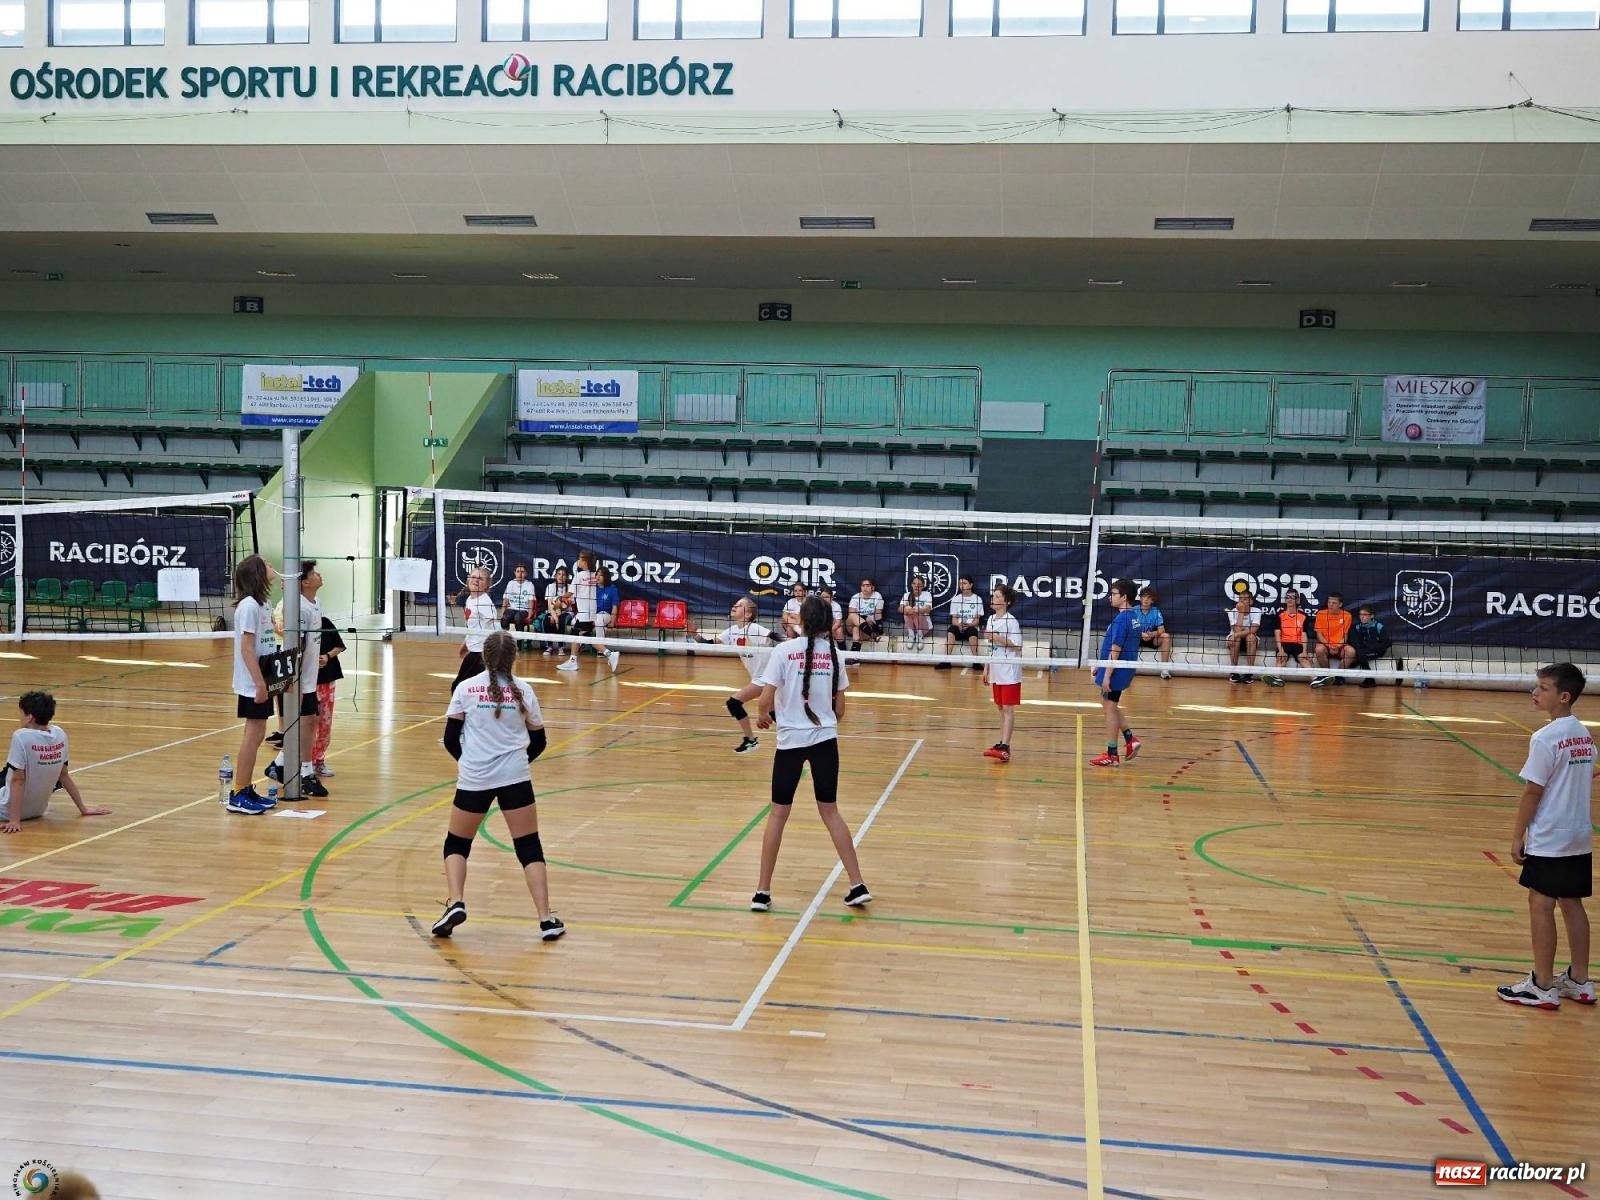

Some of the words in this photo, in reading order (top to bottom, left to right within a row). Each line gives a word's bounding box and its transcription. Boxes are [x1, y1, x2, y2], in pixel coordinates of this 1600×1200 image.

[10, 62, 169, 99] OŚRODEK
[181, 65, 317, 98] SPORTU
[330, 65, 339, 97] I
[352, 64, 538, 98] REKREACJI
[553, 56, 734, 97] RACIBÓRZ
[1395, 379, 1475, 395] MIESZKO
[49, 537, 187, 567] RACIBÓRZ
[275, 659, 284, 677] 2
[286, 655, 293, 675] 5
